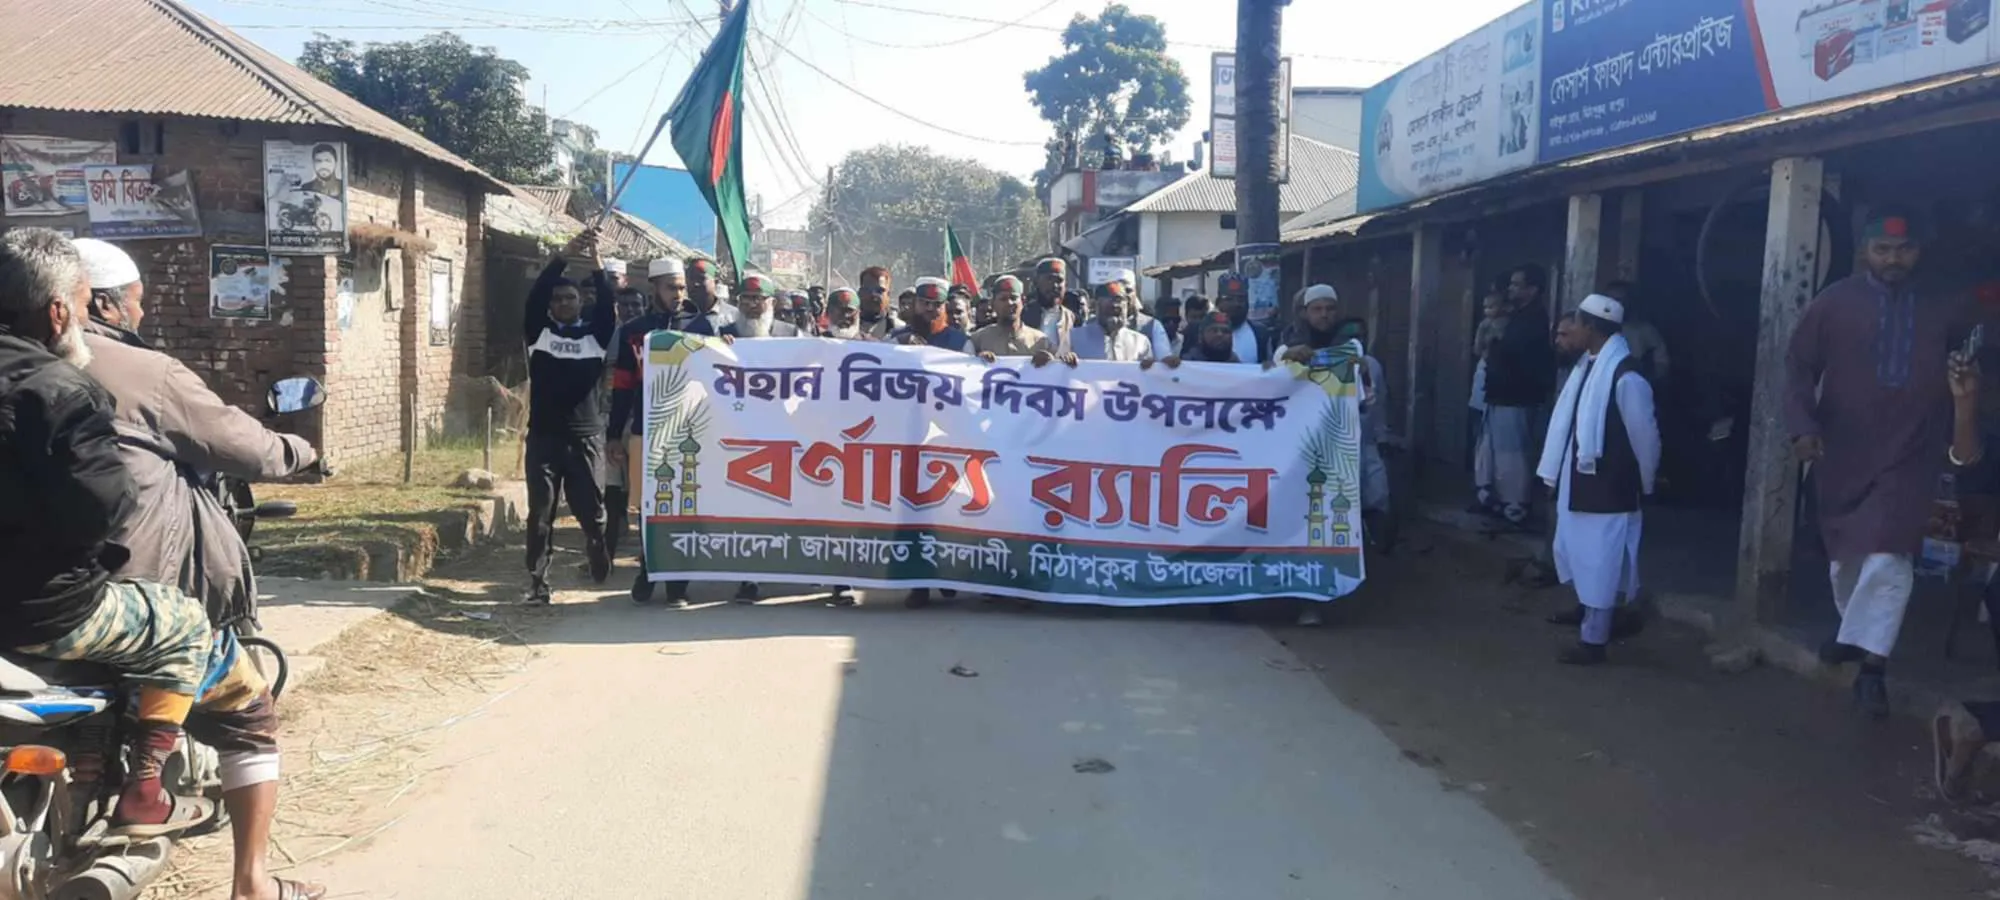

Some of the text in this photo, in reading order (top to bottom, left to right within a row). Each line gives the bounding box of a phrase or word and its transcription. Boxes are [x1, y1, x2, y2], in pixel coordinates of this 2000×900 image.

[1550, 15, 1735, 104] মেসার্স ফাহাদ এন্টারপ্রাইজ
[88, 168, 117, 207] জমি
[713, 352, 1289, 433] মহান বিজয় দিবস উপলক্ষে
[718, 415, 1000, 514] বর্ণাঢ্য
[670, 530, 1324, 590] বাংলাদেশ জামায়াতে ইসলামী, মিঠাপুকুর উপজেলা শাখা
